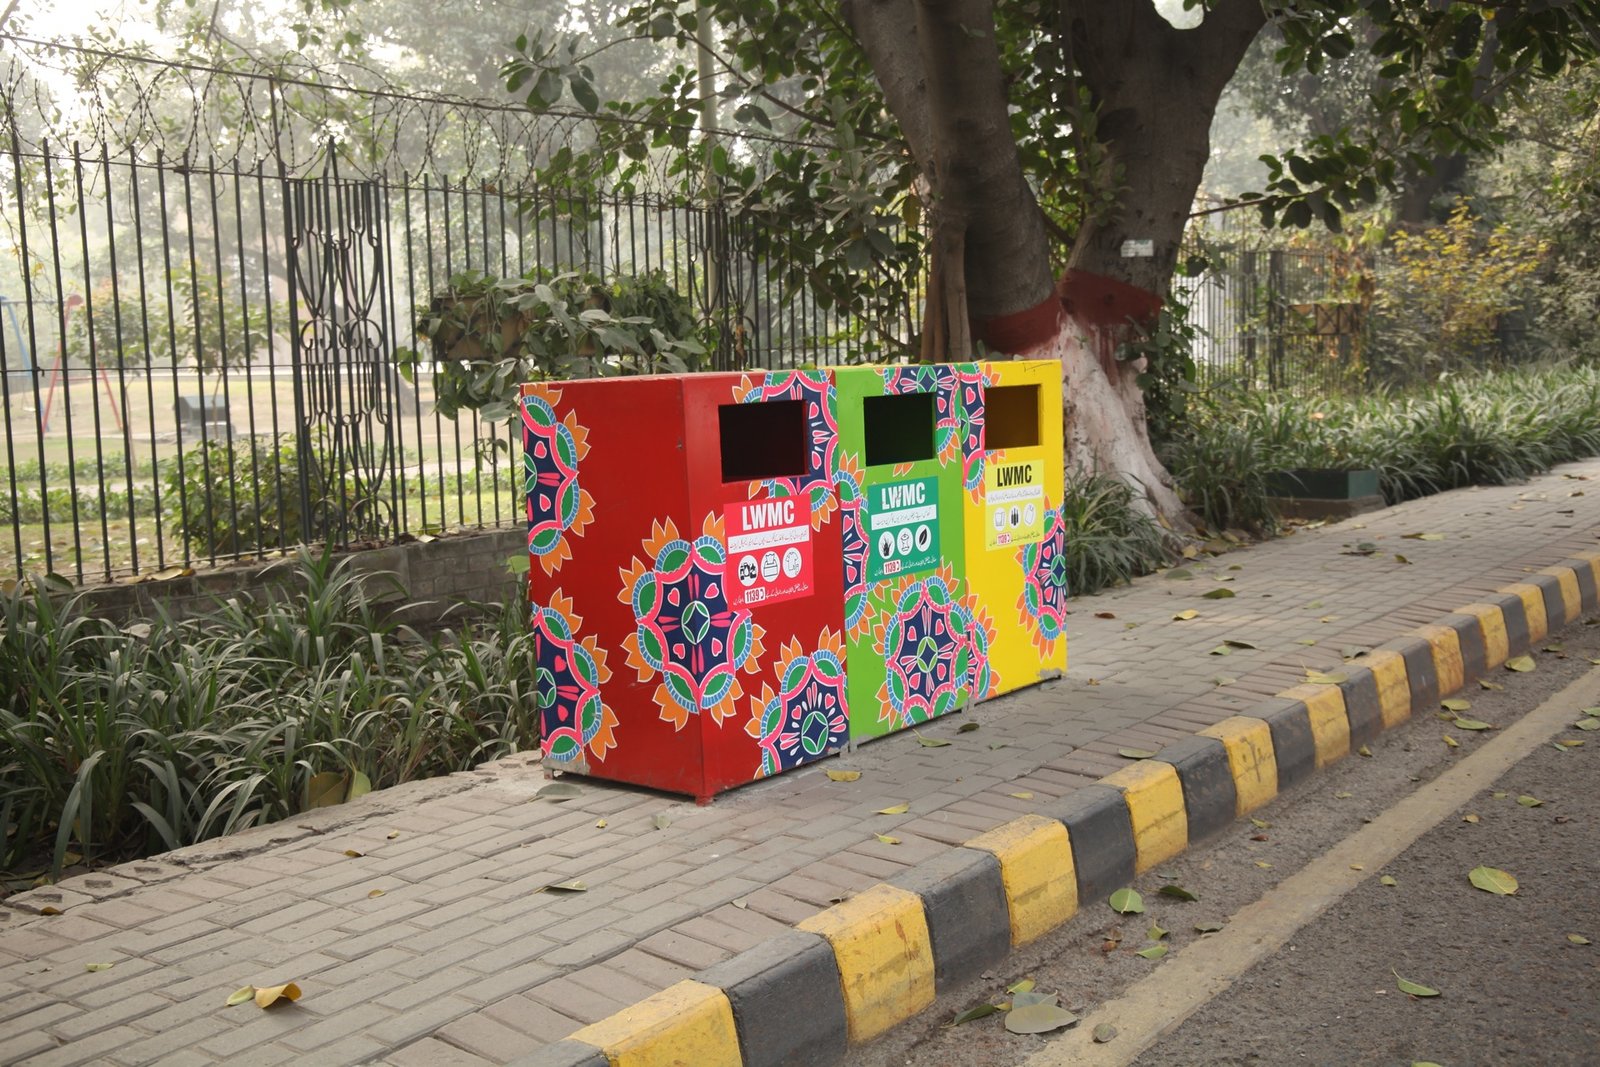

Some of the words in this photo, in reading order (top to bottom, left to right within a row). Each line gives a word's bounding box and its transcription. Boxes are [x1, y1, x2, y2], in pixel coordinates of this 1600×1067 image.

[997, 463, 1032, 487] LWMC
[882, 482, 926, 510] LWMC
[742, 500, 795, 531] LWMC
[746, 589, 760, 602] 1139
